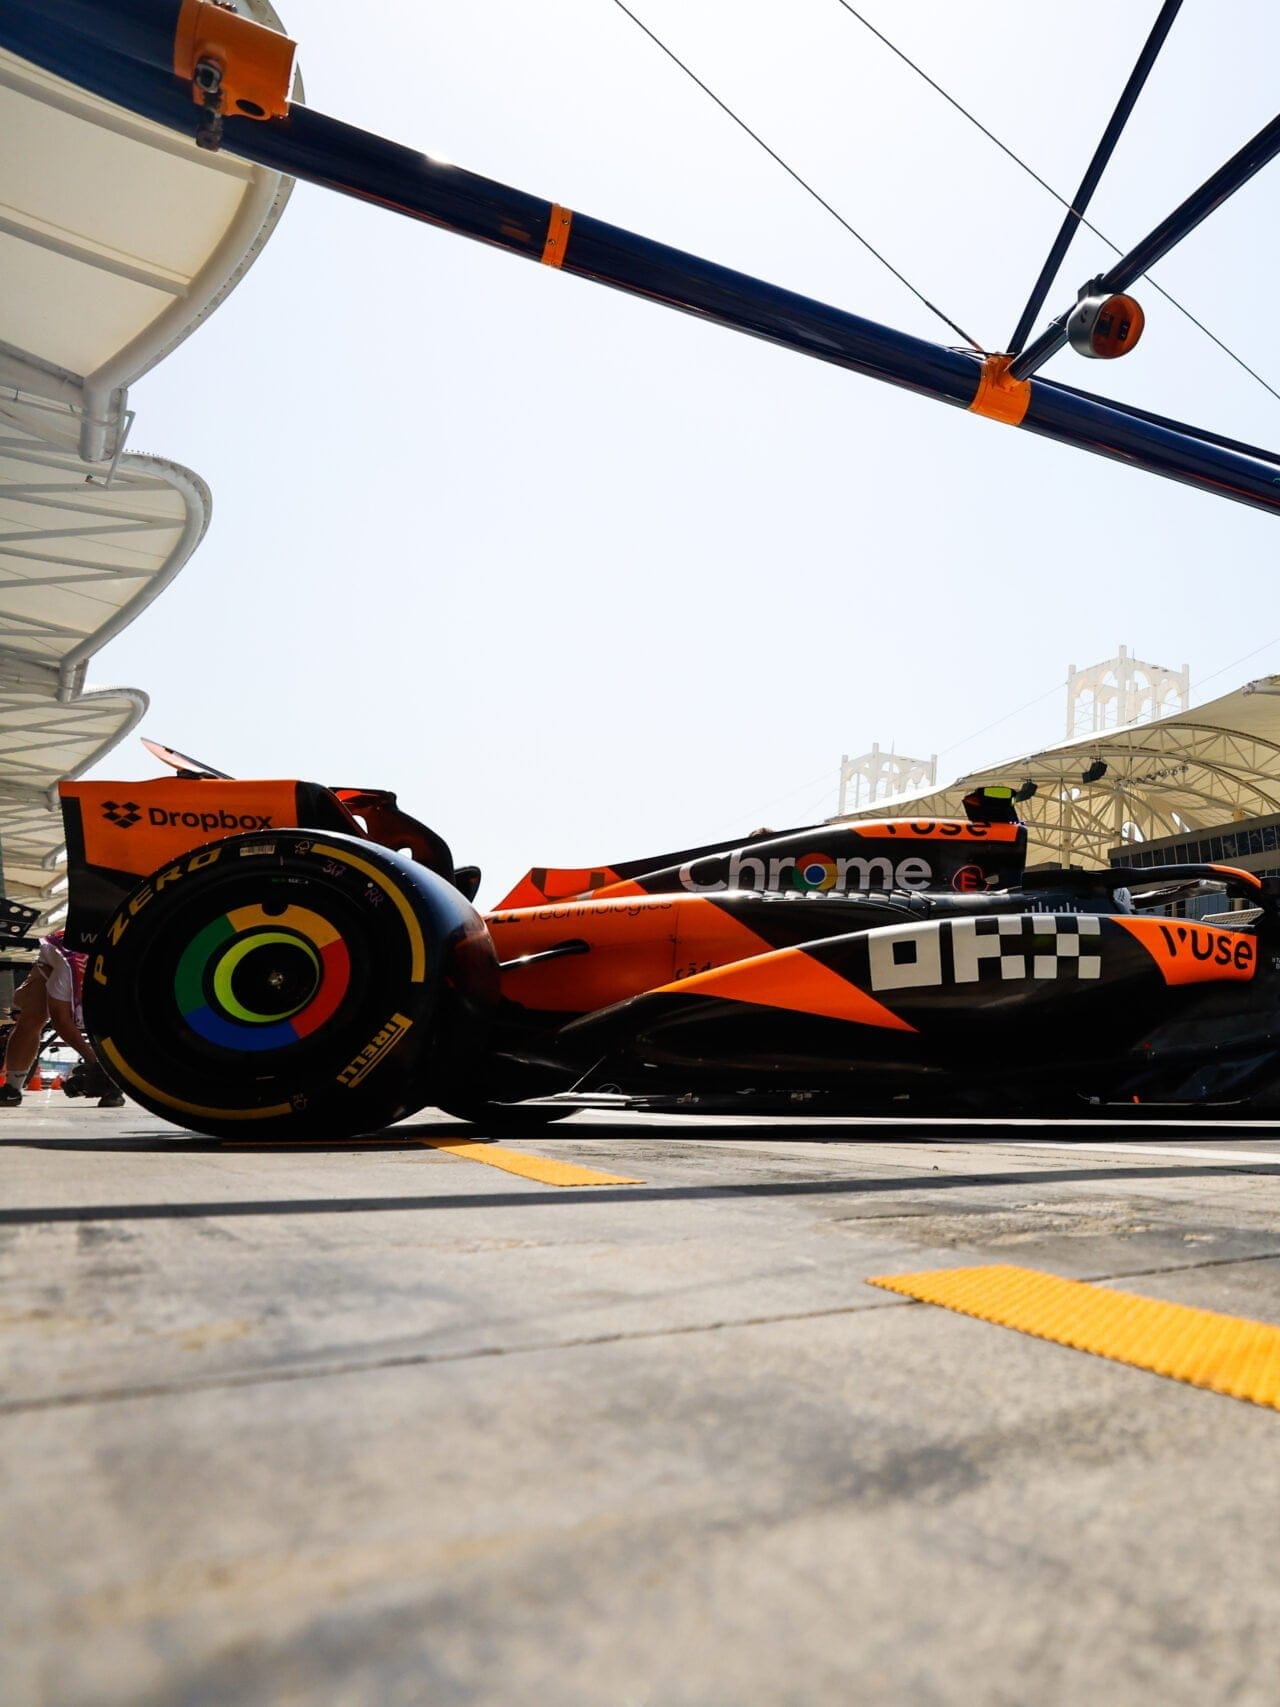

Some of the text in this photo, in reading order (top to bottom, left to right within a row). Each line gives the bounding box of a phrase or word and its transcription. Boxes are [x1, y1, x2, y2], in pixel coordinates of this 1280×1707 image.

[148, 807, 273, 832] Dropbox
[92, 847, 223, 987] P ZERO
[335, 1011, 415, 1089] PIRELLI
